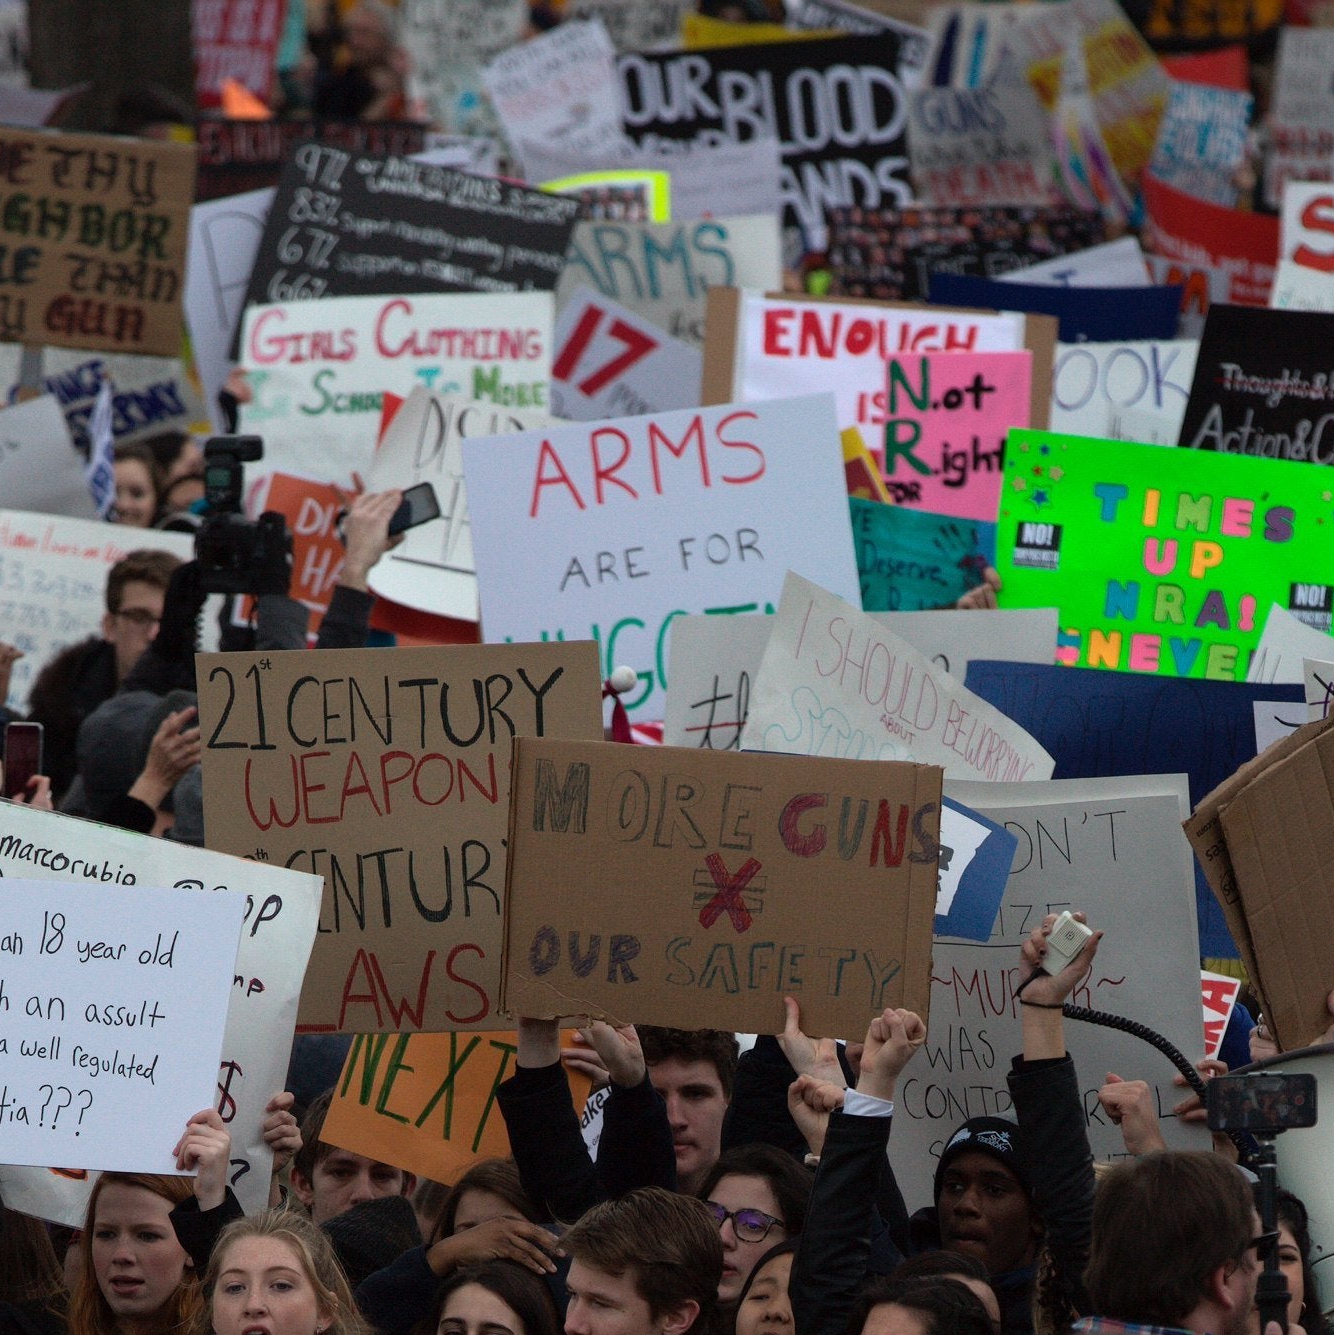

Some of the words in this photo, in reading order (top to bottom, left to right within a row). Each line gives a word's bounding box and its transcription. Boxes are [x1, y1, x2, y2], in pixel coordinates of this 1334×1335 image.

[620, 54, 720, 124] OUR
[720, 64, 907, 154] BLOOD
[48, 145, 157, 207] THY
[296, 143, 351, 191] 97%
[277, 225, 340, 269] 67%
[69, 255, 179, 302] THAN
[46, 295, 145, 344] GUN
[252, 300, 358, 365] GIRLS
[374, 300, 544, 365] CLOTHING
[764, 310, 977, 359] ENOUGH
[552, 305, 660, 396] 17
[472, 366, 545, 407] MORE
[530, 411, 765, 517] ARMS
[1021, 523, 1054, 545] NO!
[1143, 538, 1224, 579] UP
[560, 547, 649, 591] ARE
[679, 528, 765, 570] FOR
[1104, 580, 1257, 632] NRA!
[1294, 583, 1326, 606] NO!
[816, 617, 937, 731] SHOULD
[286, 667, 564, 750] CENTURY
[880, 714, 915, 745] ABOUT
[533, 759, 761, 851] MORE
[778, 789, 941, 868] GUNS
[0, 933, 24, 955] an
[40, 911, 67, 955] 18
[77, 941, 127, 963] year
[138, 931, 179, 970] old
[529, 925, 641, 984] OUR
[667, 936, 899, 1009] SAFETY
[26, 1000, 65, 1021] an
[85, 1000, 167, 1027] assult
[20, 1038, 60, 1060] well
[71, 1045, 159, 1082] regulated
[925, 1024, 995, 1071] WAS
